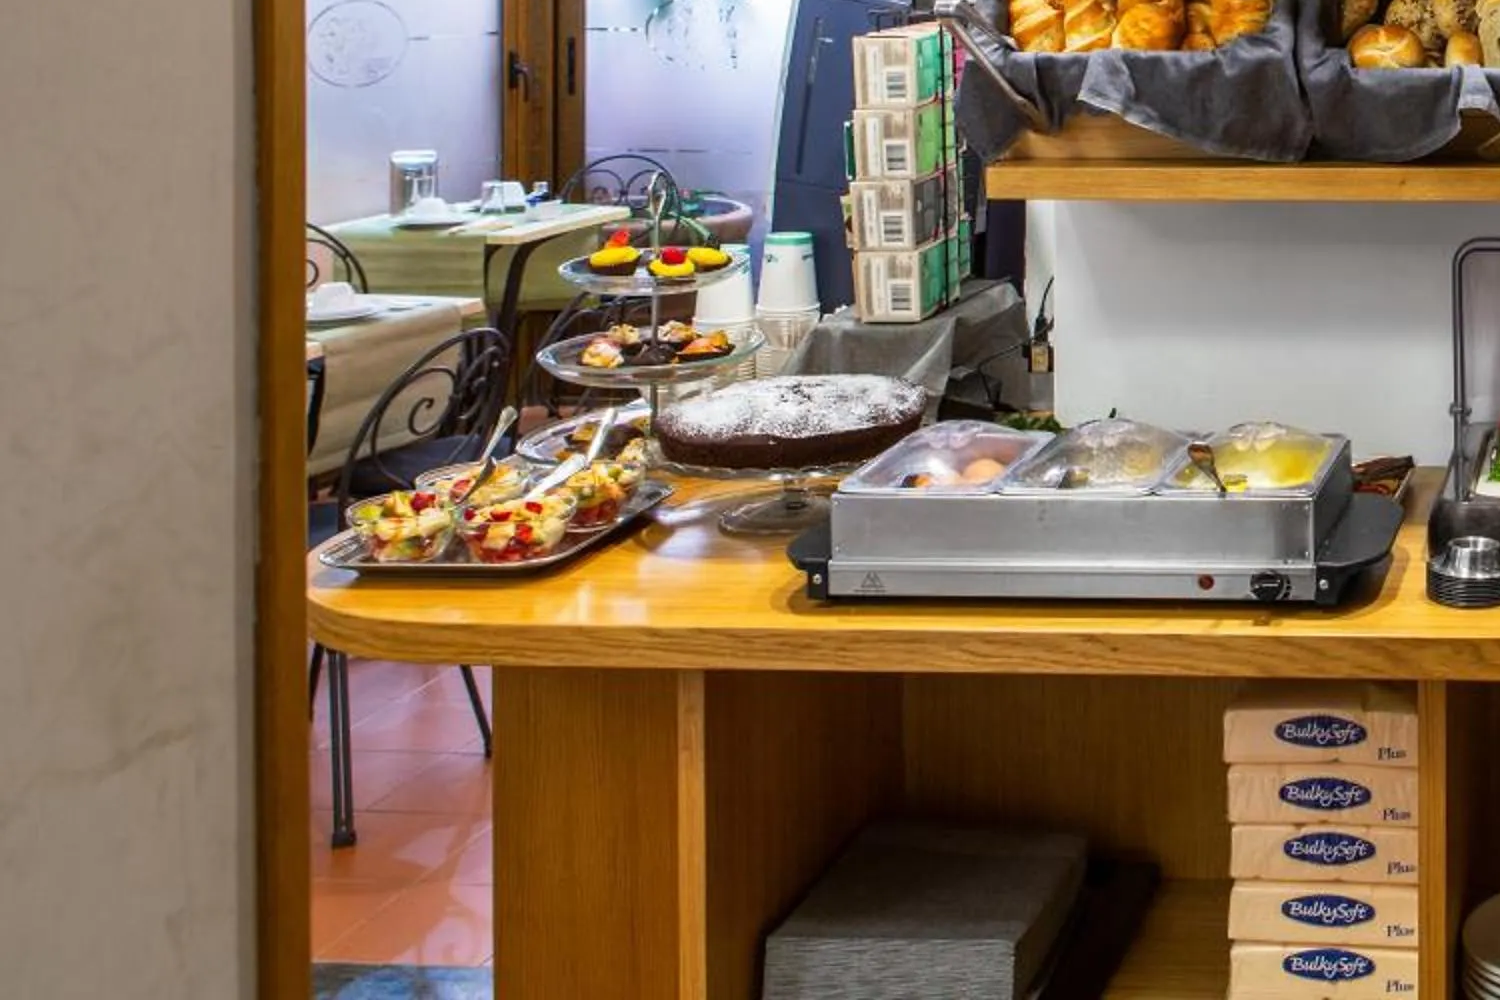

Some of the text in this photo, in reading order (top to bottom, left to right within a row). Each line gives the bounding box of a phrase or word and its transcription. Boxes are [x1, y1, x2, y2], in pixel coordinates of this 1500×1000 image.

[1281, 723, 1361, 745] BulkySoft
[1378, 747, 1406, 760] Plus
[1286, 784, 1366, 807] BulkySoft
[1383, 808, 1411, 821] Plus
[1291, 839, 1367, 862] BulkySoft
[1288, 900, 1367, 924] BulkySoft
[1387, 924, 1415, 937] Plus
[1289, 955, 1367, 979] BulkySoft
[1386, 979, 1414, 993] Plus
